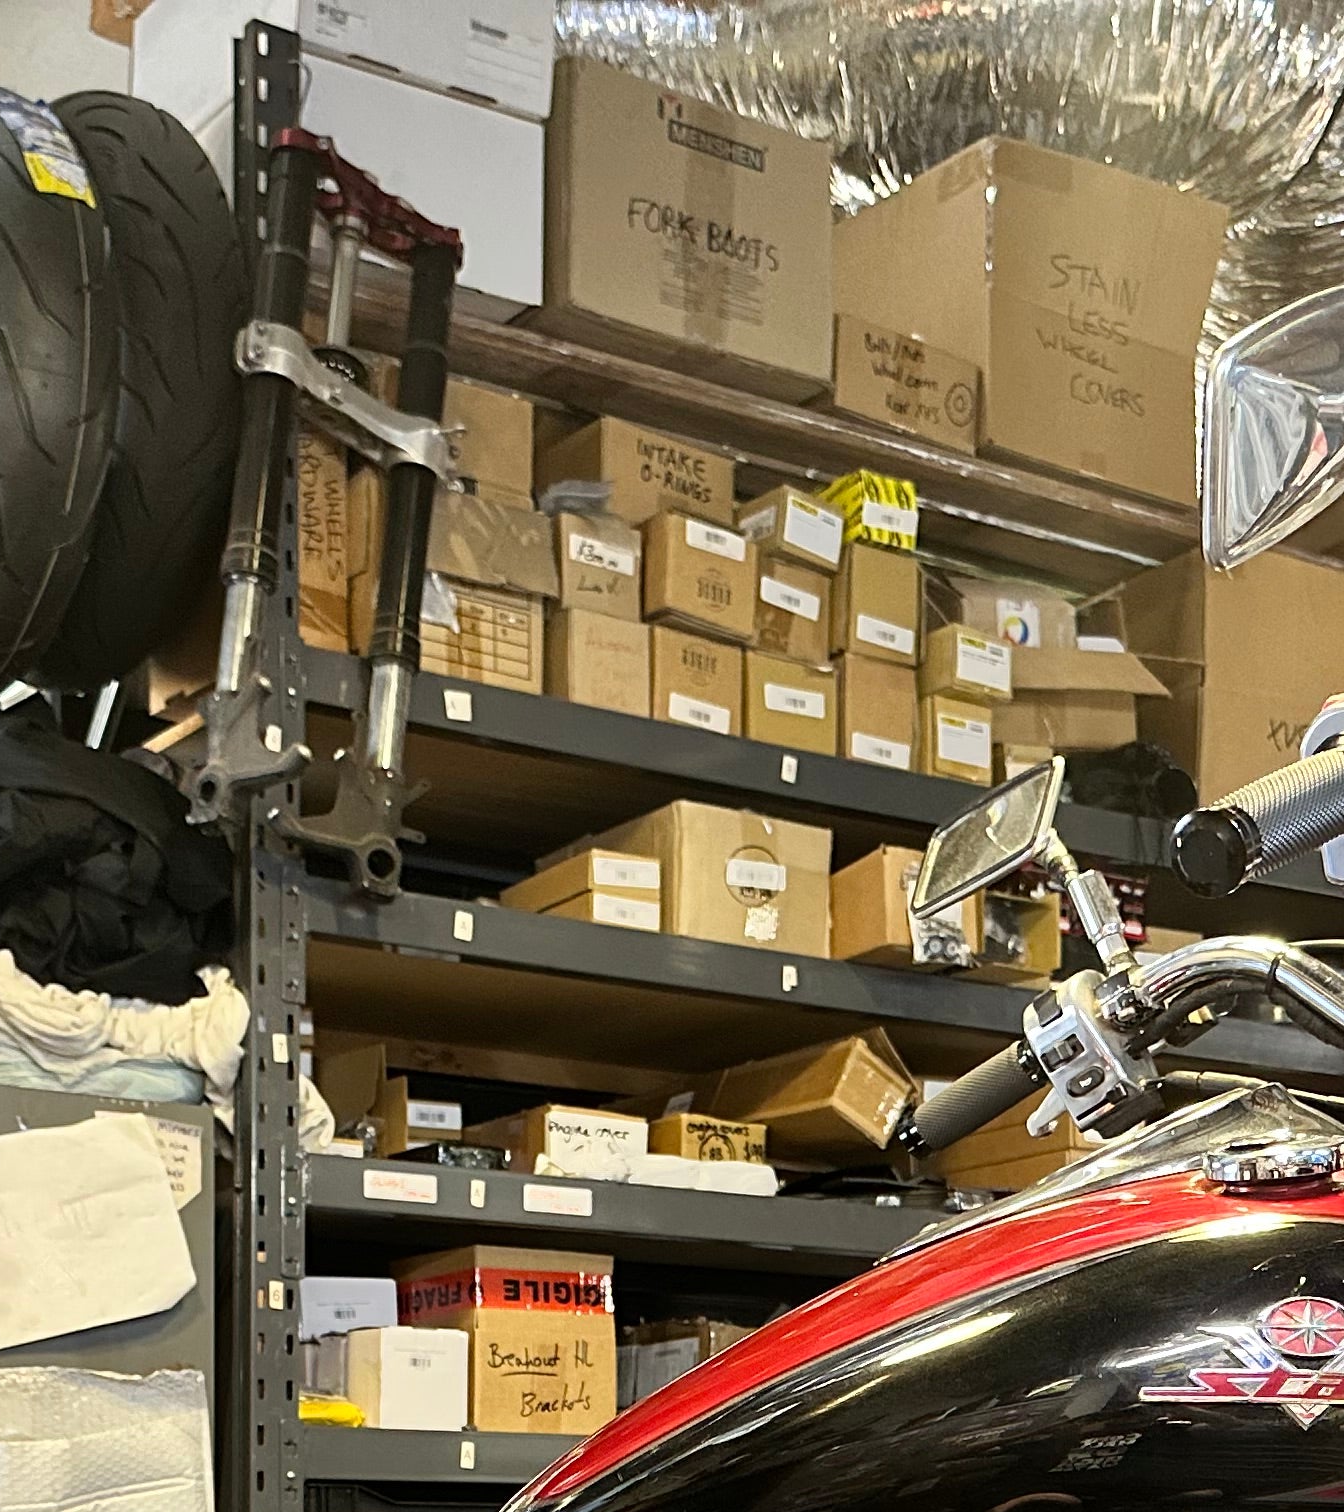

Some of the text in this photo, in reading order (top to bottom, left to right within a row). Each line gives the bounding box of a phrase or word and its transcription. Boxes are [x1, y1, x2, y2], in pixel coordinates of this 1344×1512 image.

[628, 198, 780, 272] FORK BOOTS
[1068, 301, 1130, 346] LESS
[1070, 371, 1146, 417] COVERS
[636, 438, 706, 481] INTAKE
[639, 463, 713, 505] O-RINGS
[322, 478, 346, 583] WHEELS
